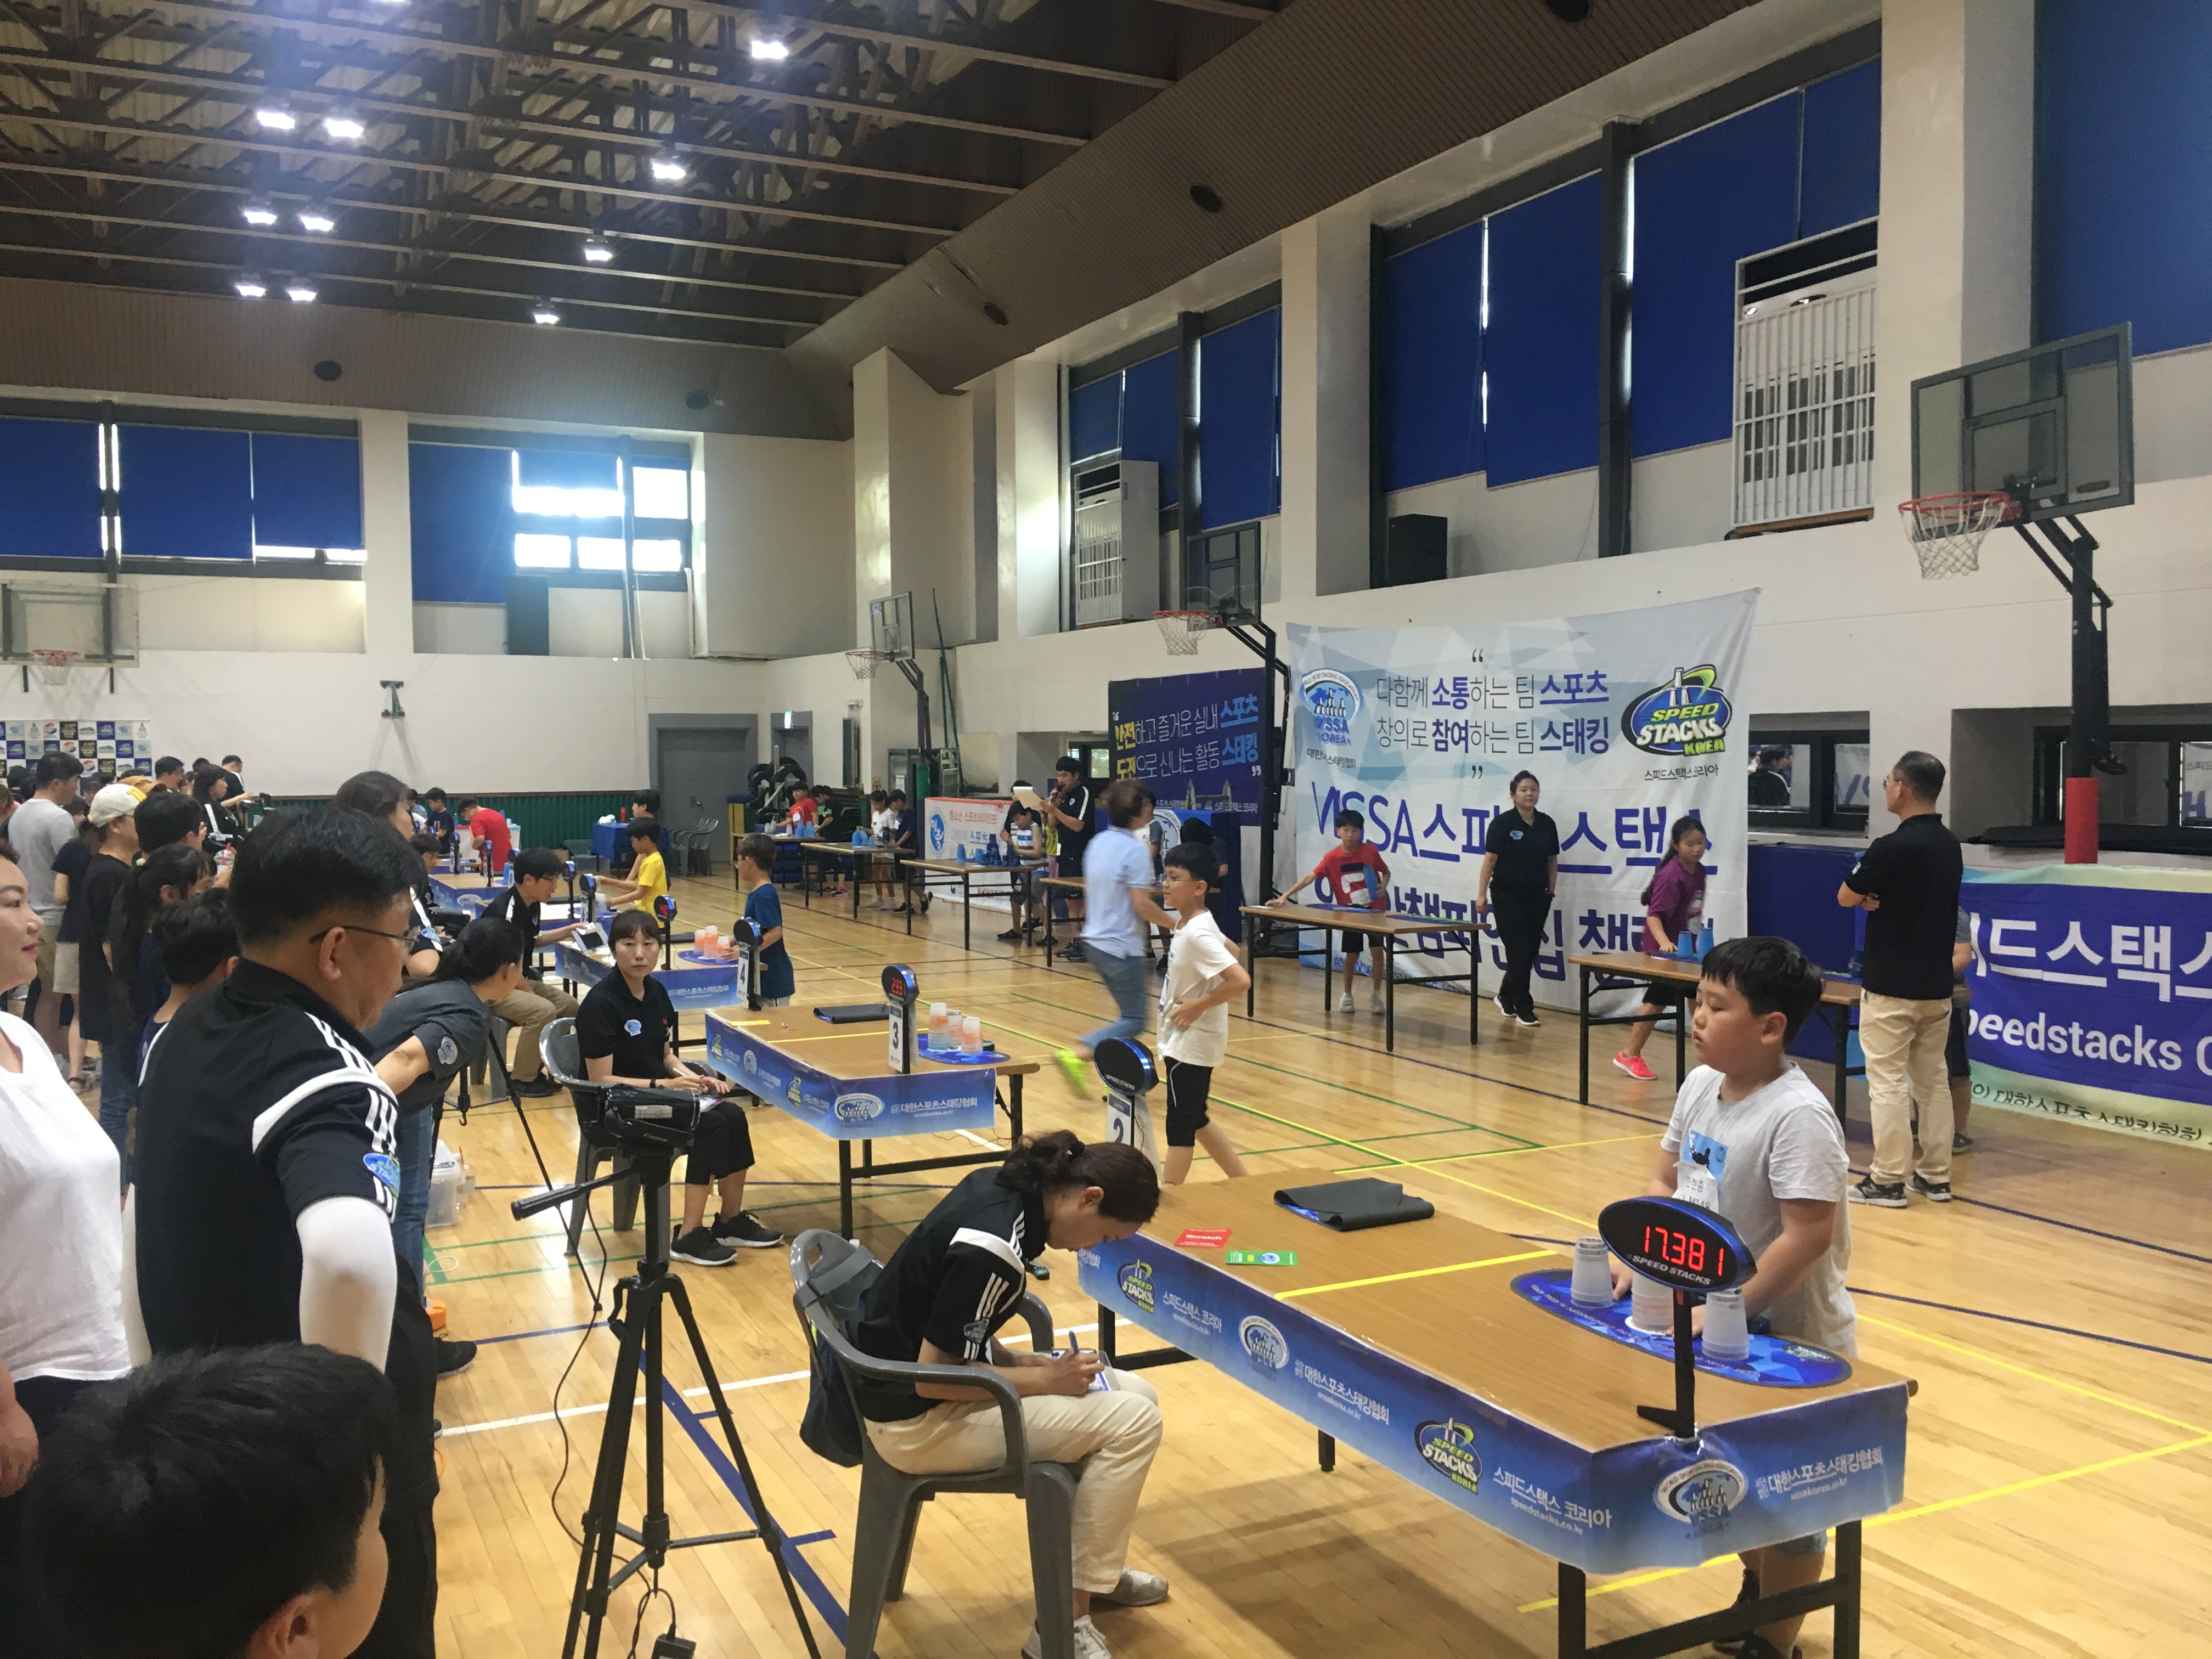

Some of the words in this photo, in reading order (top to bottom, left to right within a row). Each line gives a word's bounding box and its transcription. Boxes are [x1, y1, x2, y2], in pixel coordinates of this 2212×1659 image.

[1376, 676, 1428, 708] 다함께
[1431, 676, 1510, 709] 소통하는
[1515, 674, 1534, 708] 팀
[1539, 670, 1610, 705] 스포츠
[1114, 718, 1156, 751] 안전하고
[1158, 710, 1192, 742] 즐거운
[1220, 693, 1259, 729] 스포츠
[1650, 702, 1719, 723] SPEED
[1376, 716, 1429, 750] 창의로
[1431, 718, 1510, 754] 참여하는
[1515, 720, 1534, 754] 팀
[1539, 716, 1610, 755] 스태킹
[1160, 748, 1194, 777] 신나는
[1222, 732, 1259, 766] 스태킹
[892, 1021, 899, 1050] 3
[1968, 1008, 2182, 1071] peedstacks
[1113, 1118, 1124, 1144] 2
[1126, 1274, 1153, 1291] SPEED
[1632, 1255, 1669, 1272] SPEED
[1669, 1267, 1711, 1285] STACKS
[1121, 1280, 1154, 1305] STACKS
[1200, 1310, 1223, 1333] 코리아
[1304, 1365, 1390, 1426] 대한스포츠스태킹협회
[1422, 1443, 1478, 1483] STACKS
[1431, 1436, 1475, 1464] SPEED
[1451, 1472, 1479, 1496] KOREA
[1768, 1446, 1883, 1494] 대한스포츠스태킹협회
[1493, 1466, 1562, 1515] 스피드스택스
[1564, 1500, 1612, 1529] 코리아
